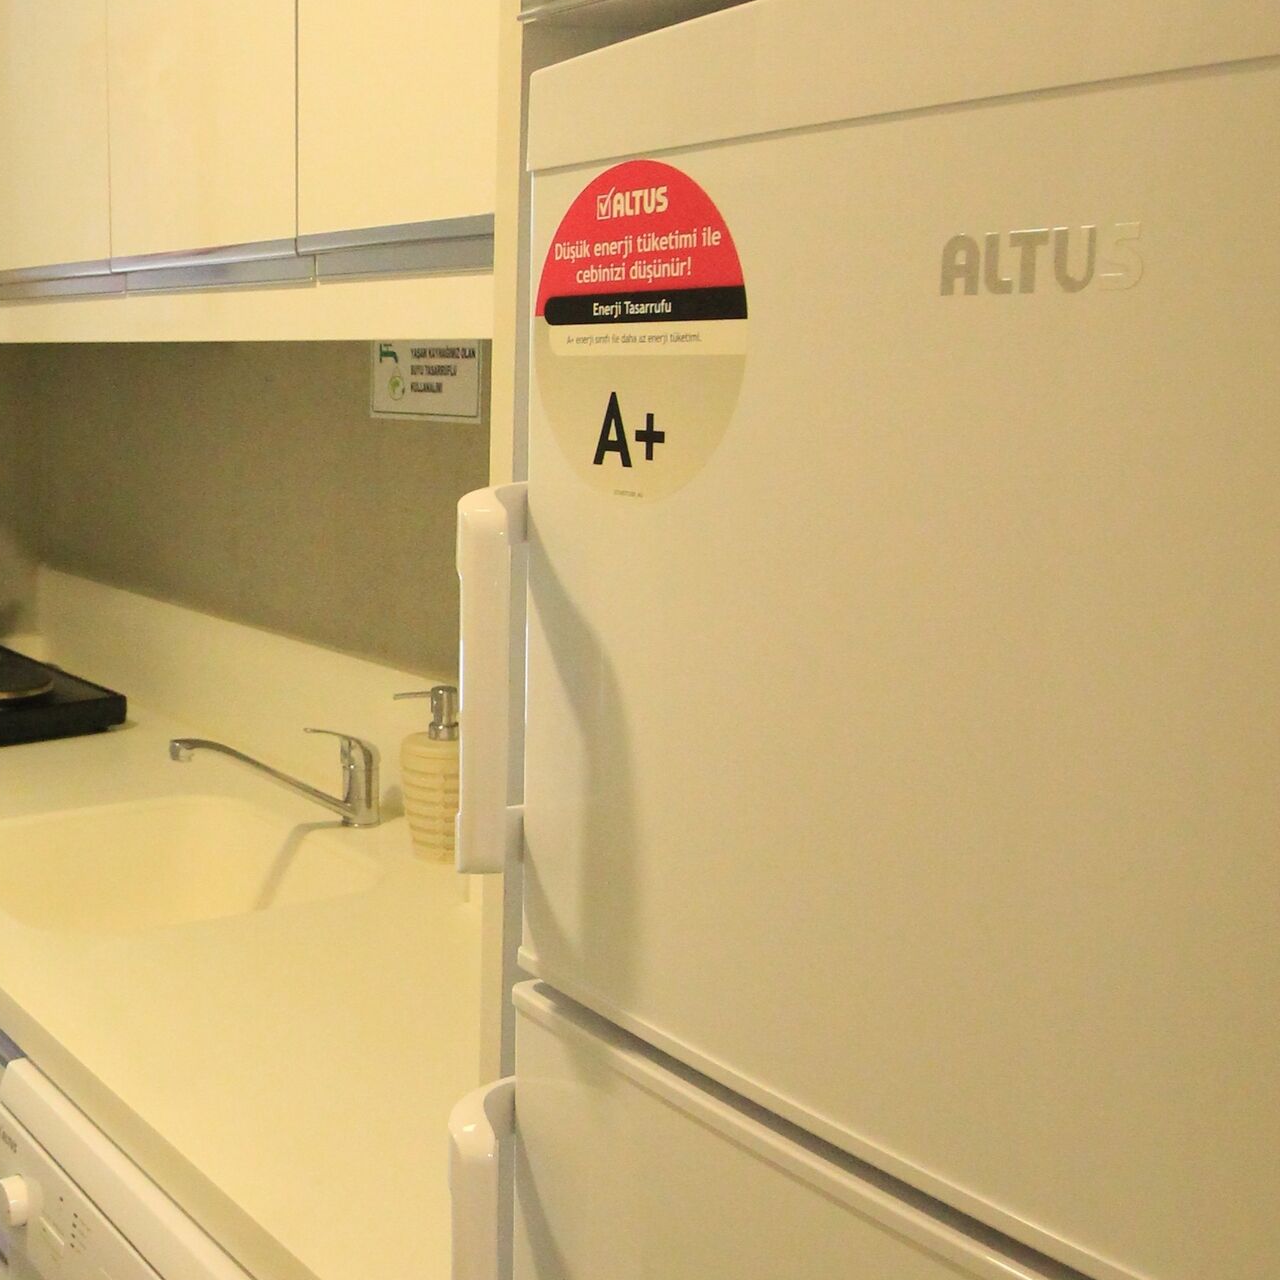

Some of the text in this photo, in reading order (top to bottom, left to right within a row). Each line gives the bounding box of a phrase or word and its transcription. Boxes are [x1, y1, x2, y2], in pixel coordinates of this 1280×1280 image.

[612, 186, 669, 218] ALTUS
[554, 226, 721, 263] Düşük enerji tüketimi ile
[940, 222, 1144, 296] ALTUS
[576, 256, 692, 284] cebinizi düşünür!
[592, 299, 672, 318] Enerji Tasarrufu
[592, 391, 665, 468] A+
